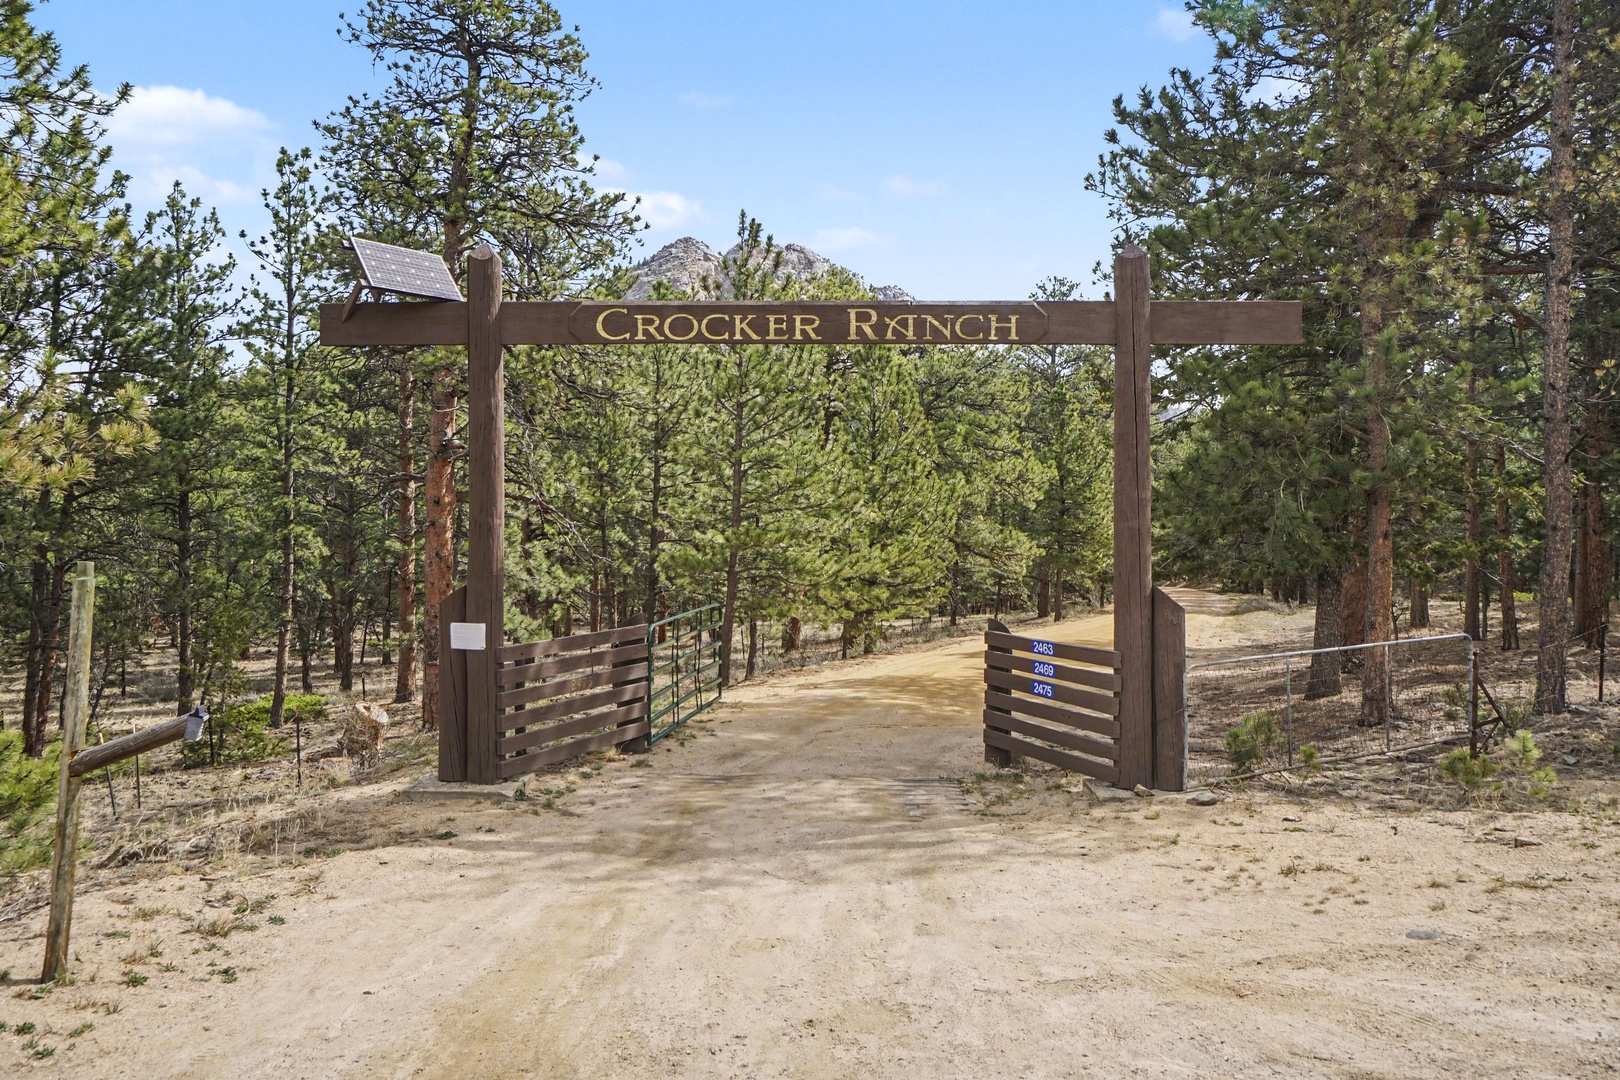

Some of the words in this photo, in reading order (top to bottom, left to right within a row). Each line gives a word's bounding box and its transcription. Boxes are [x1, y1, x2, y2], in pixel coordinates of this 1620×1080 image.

[596, 308, 822, 340] CROCKER
[847, 308, 1020, 340] RANCH
[1033, 641, 1054, 655] 2463
[1034, 662, 1054, 676] 2469
[1033, 682, 1053, 697] 2475
